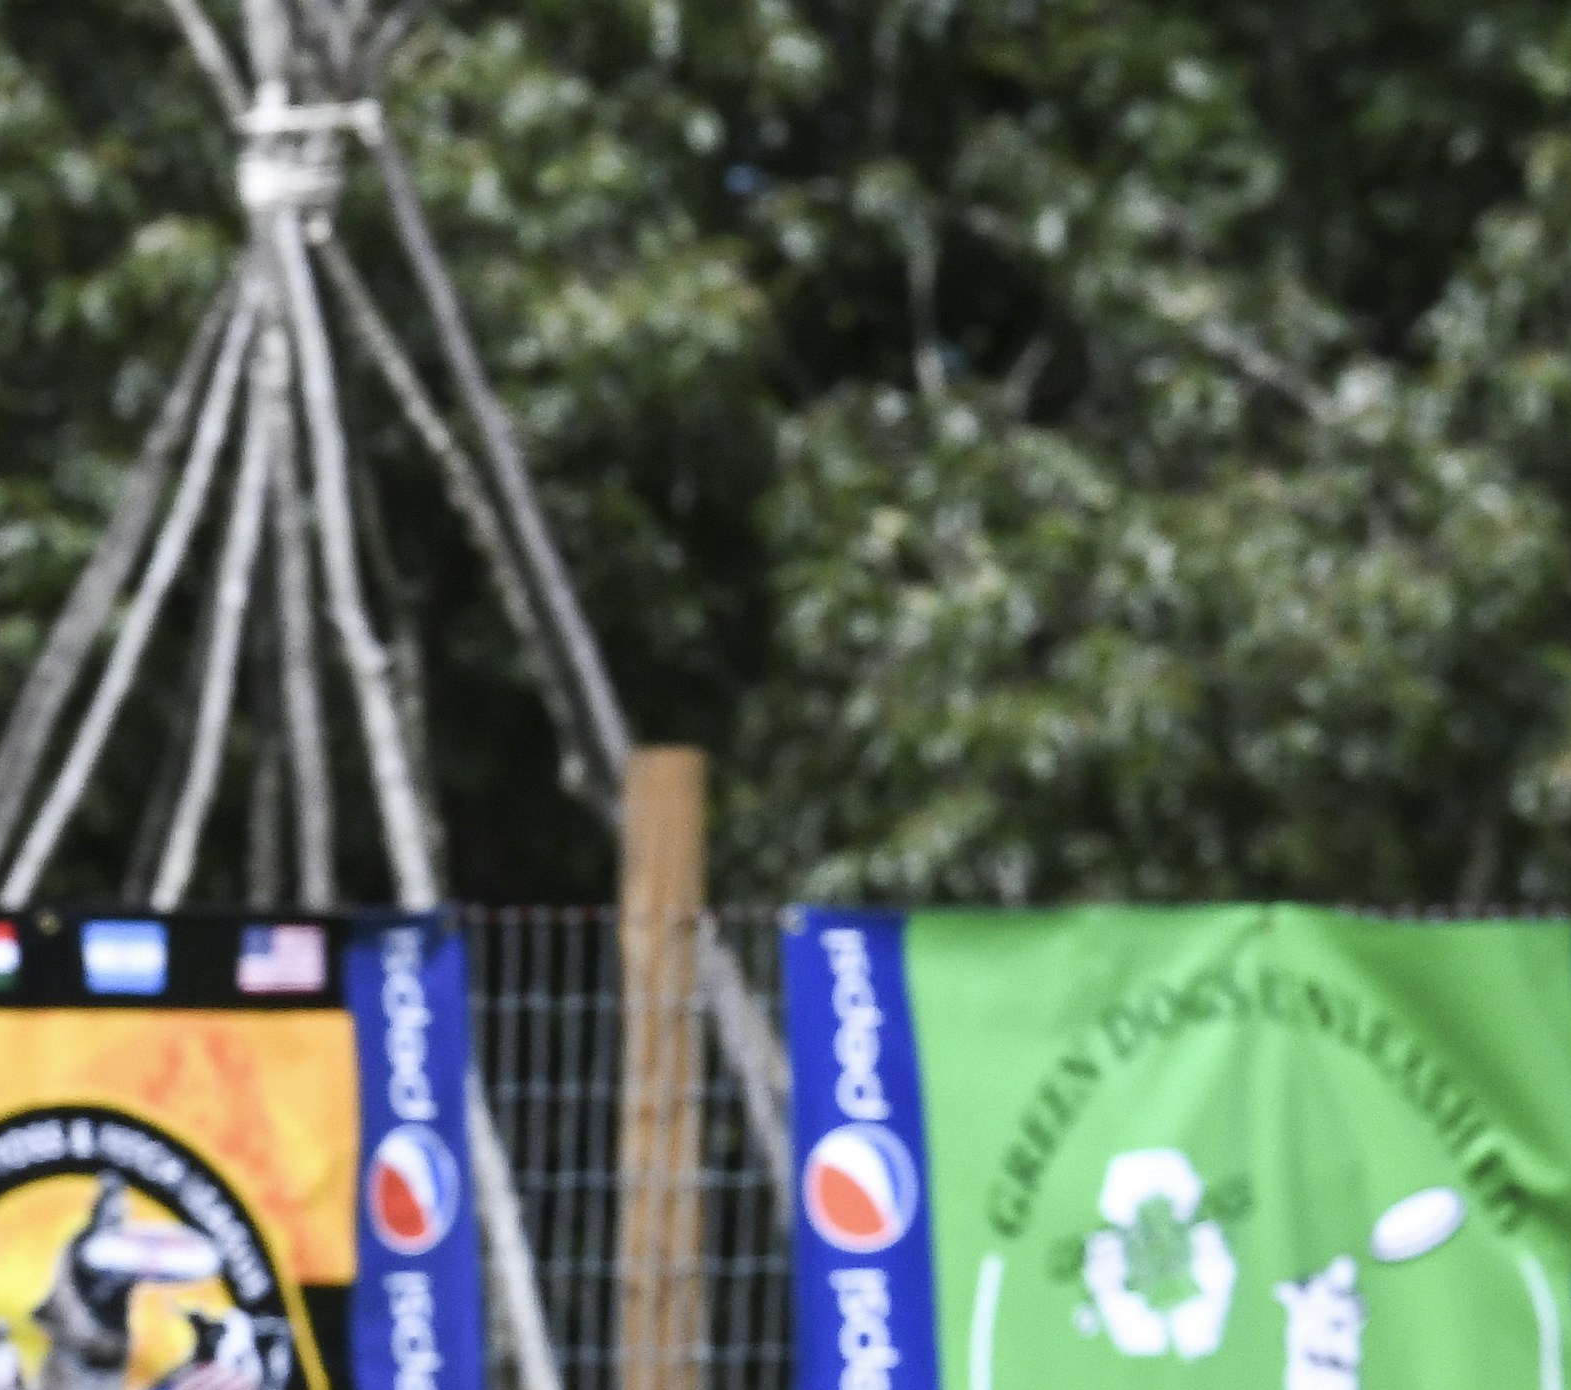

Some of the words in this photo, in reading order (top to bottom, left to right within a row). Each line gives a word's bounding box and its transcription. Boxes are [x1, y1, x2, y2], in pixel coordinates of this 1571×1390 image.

[382, 926, 437, 1121] pepsi
[821, 928, 890, 1121] pepsi
[1099, 969, 1248, 1059] DOGS
